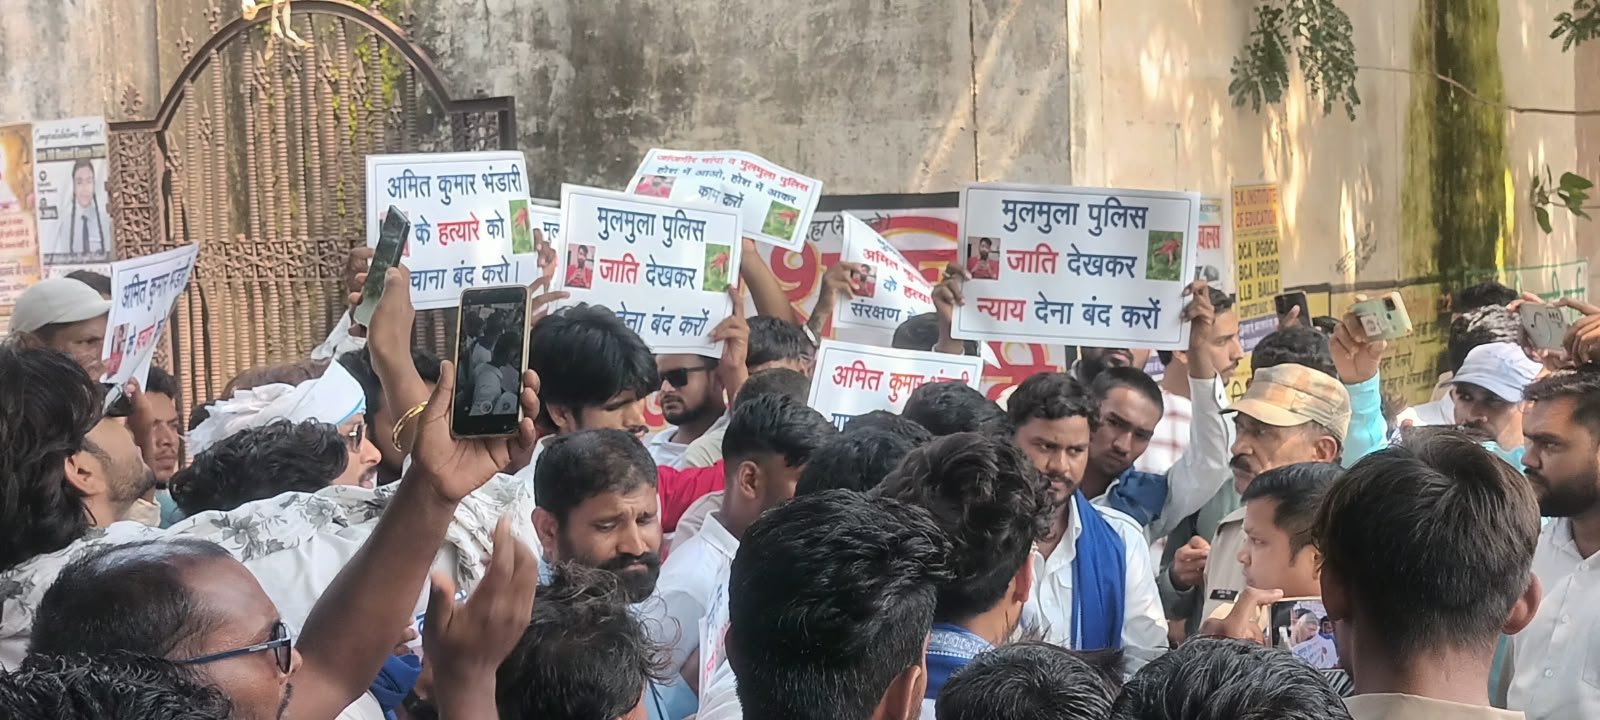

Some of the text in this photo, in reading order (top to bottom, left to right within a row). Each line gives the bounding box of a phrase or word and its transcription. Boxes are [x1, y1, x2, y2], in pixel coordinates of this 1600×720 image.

[388, 164, 522, 205] अमित कुमार भंडारी
[657, 165, 678, 175] होश
[731, 173, 752, 188] होश
[768, 186, 797, 204] आकर
[740, 158, 777, 181] मुलमुला
[779, 175, 810, 193] पुलिस
[698, 185, 721, 200] काम
[414, 210, 505, 246] के हत्यारे को
[597, 206, 657, 243] मुलमुला
[662, 209, 707, 248] पुलिस
[1002, 196, 1149, 236] मुलमुला पुलिस
[1236, 212, 1244, 228] OF
[863, 248, 898, 270] अमित
[1006, 243, 1138, 279] जाति देखकर
[1238, 241, 1252, 260] DCA
[453, 260, 476, 288] बंद
[599, 252, 697, 291] जाति देखकर
[1239, 263, 1253, 281] BCA
[122, 273, 148, 309] अमित
[147, 273, 170, 312] कुमार
[883, 276, 931, 304] के हत्या
[1240, 284, 1252, 301] LLB
[651, 306, 675, 336] बंद
[679, 308, 710, 336] करों
[851, 298, 902, 322] संरक्षण
[977, 291, 1161, 330] न्याय देना बंद करों
[832, 359, 884, 392] अमित
